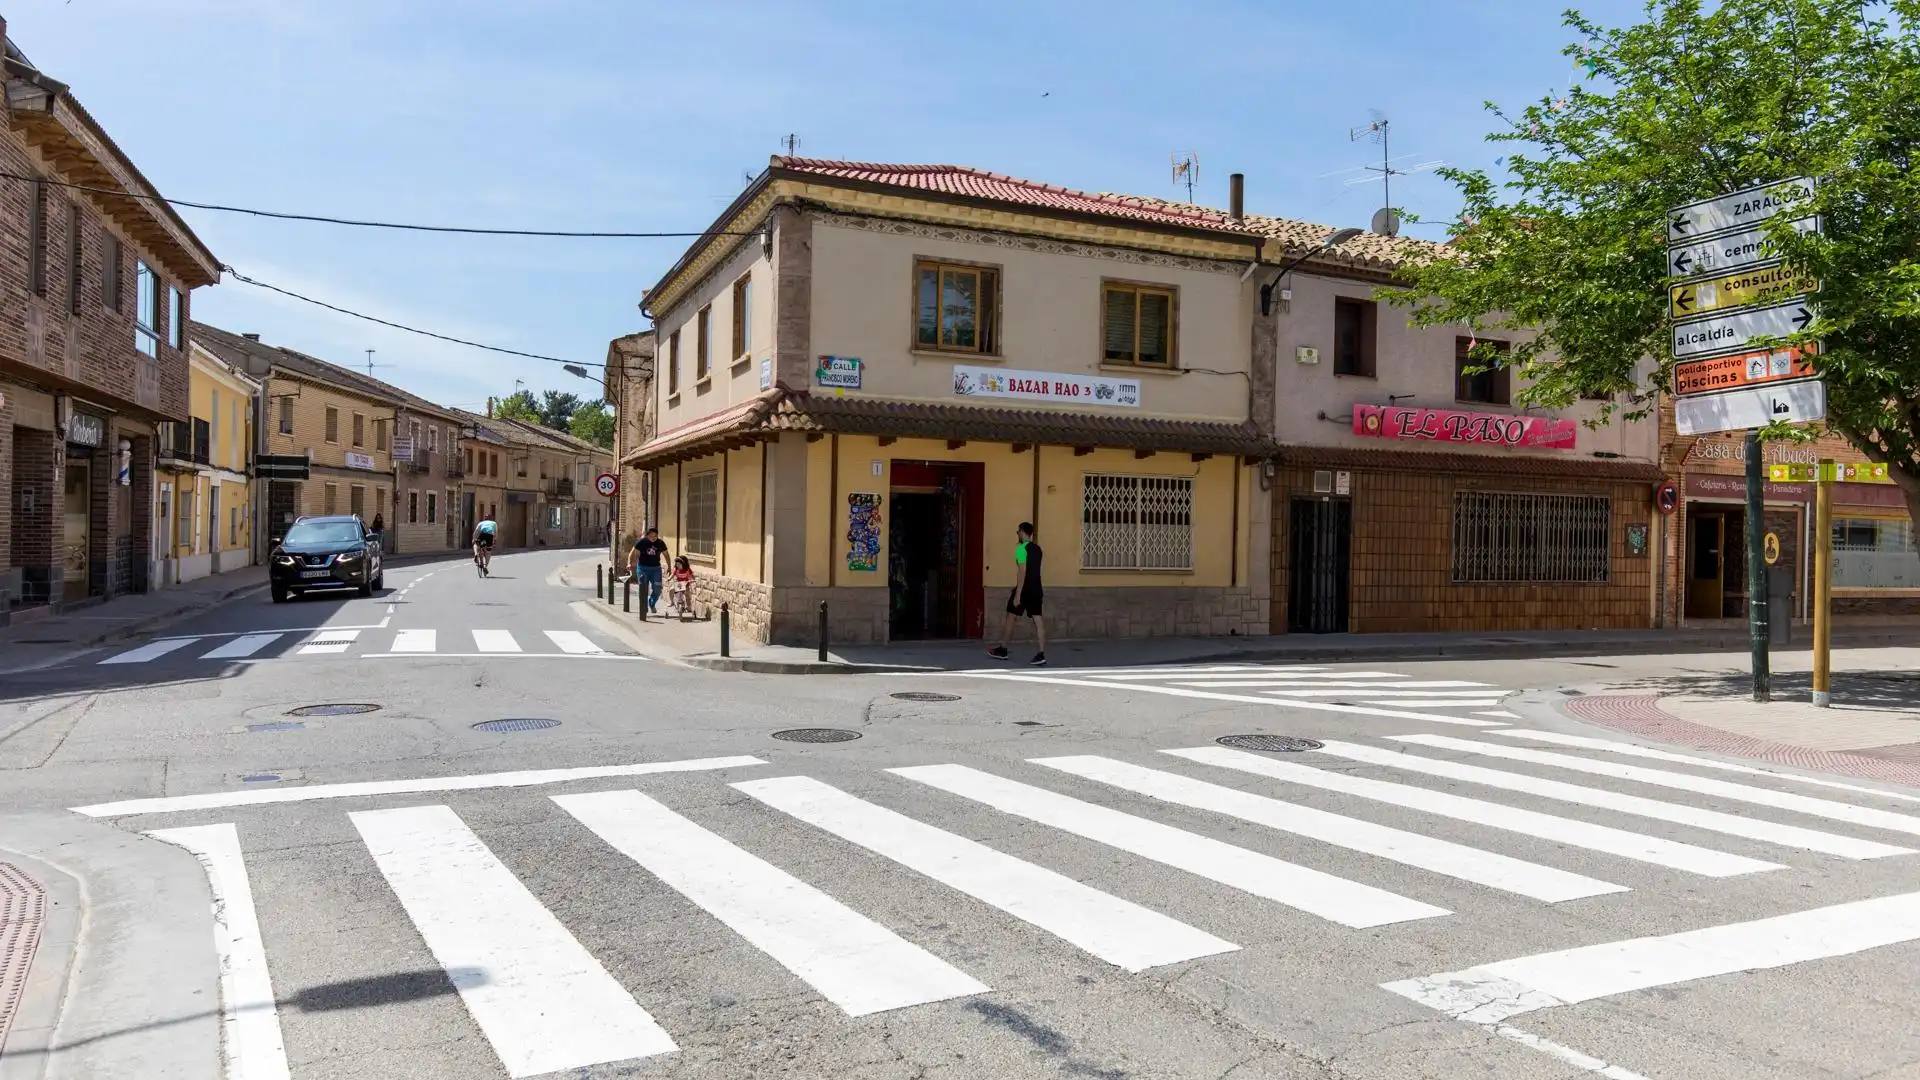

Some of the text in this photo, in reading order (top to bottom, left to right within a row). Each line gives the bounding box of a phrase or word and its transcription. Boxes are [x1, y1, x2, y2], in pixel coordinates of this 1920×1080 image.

[1725, 229, 1807, 258] cemeni
[1725, 267, 1806, 291] consultori
[1758, 278, 1815, 296] médco
[1677, 326, 1735, 346] alcaldía
[833, 362, 856, 372] CALLE
[1678, 359, 1742, 377] polideportivo
[1008, 378, 1092, 397] BAZAR HAO 3
[1679, 372, 1737, 392] piscinas
[1394, 409, 1439, 437] EL
[1444, 413, 1525, 444] PASO
[1695, 437, 1730, 459] Casa
[1771, 444, 1818, 465] Abuela
[1846, 468, 1855, 476] 95
[600, 481, 613, 490] 30
